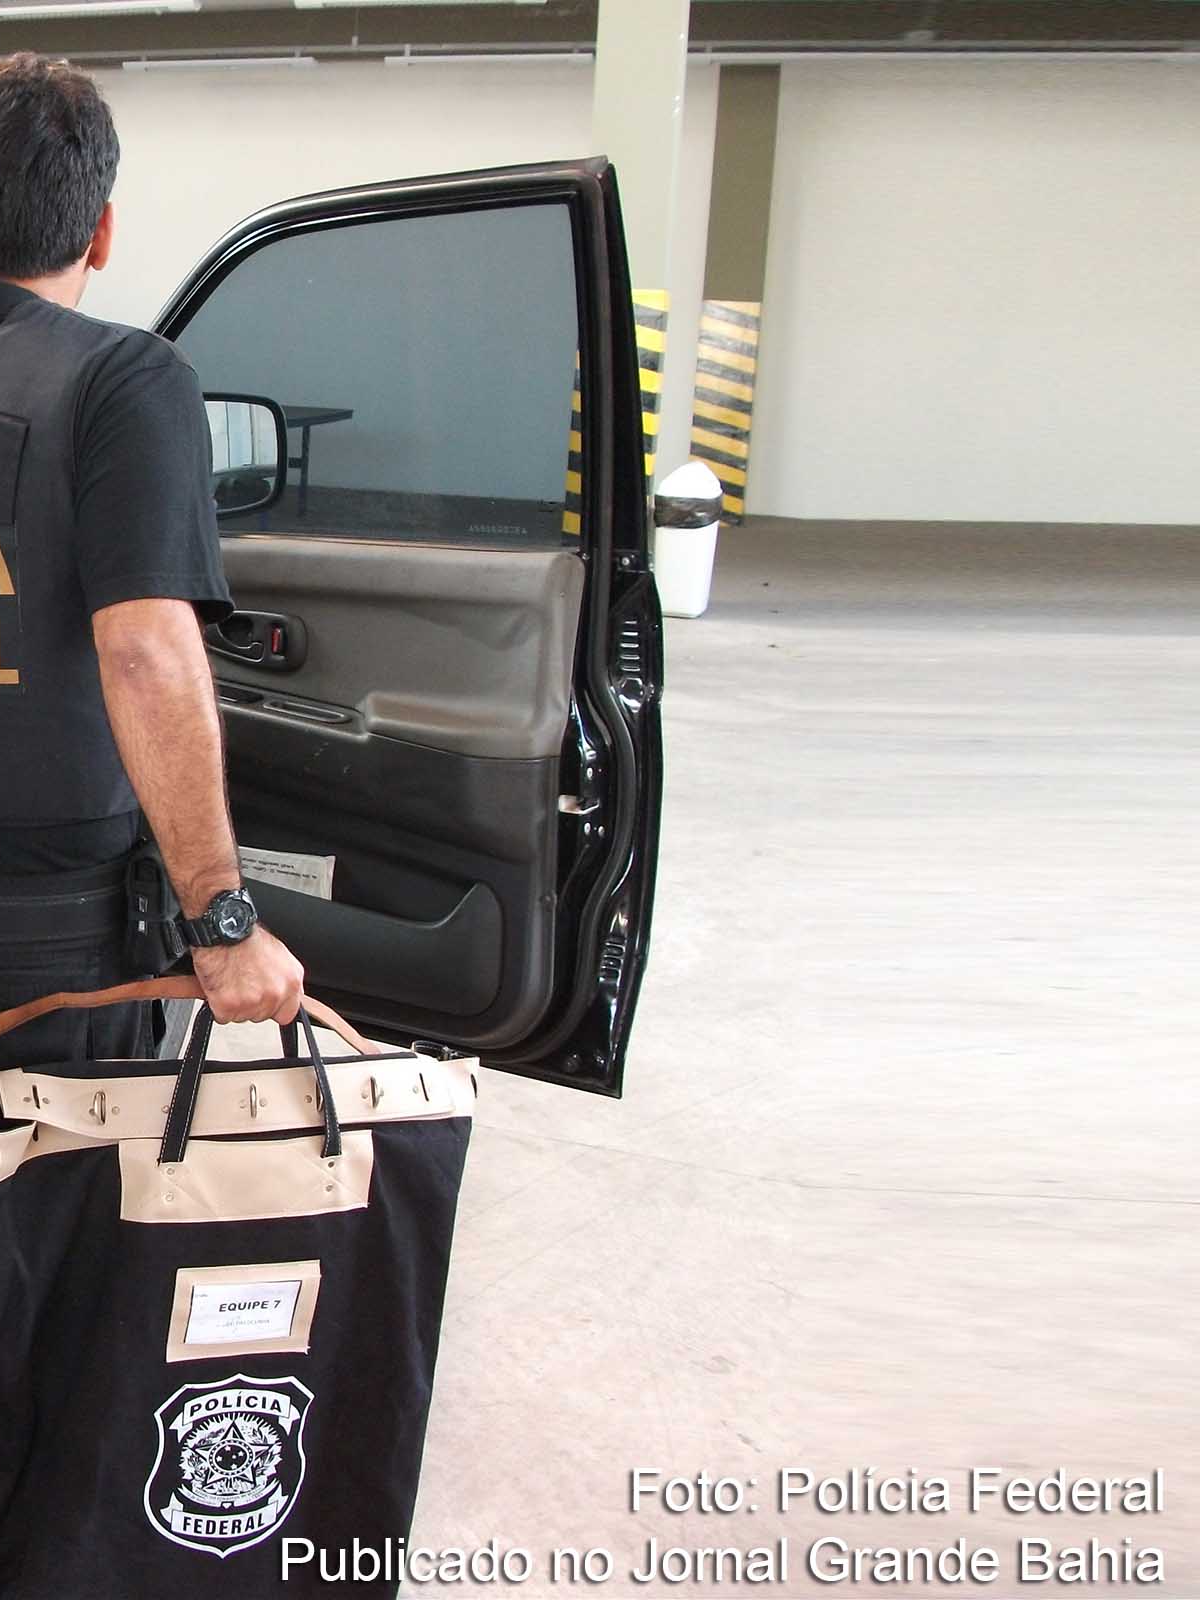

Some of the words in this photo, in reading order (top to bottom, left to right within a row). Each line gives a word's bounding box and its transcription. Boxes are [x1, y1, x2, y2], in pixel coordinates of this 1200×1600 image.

[218, 1300, 270, 1313] EQUIPE
[273, 1299, 282, 1309] 7
[189, 1391, 282, 1417] POLÍCIA
[182, 1516, 266, 1535] FEDERAL
